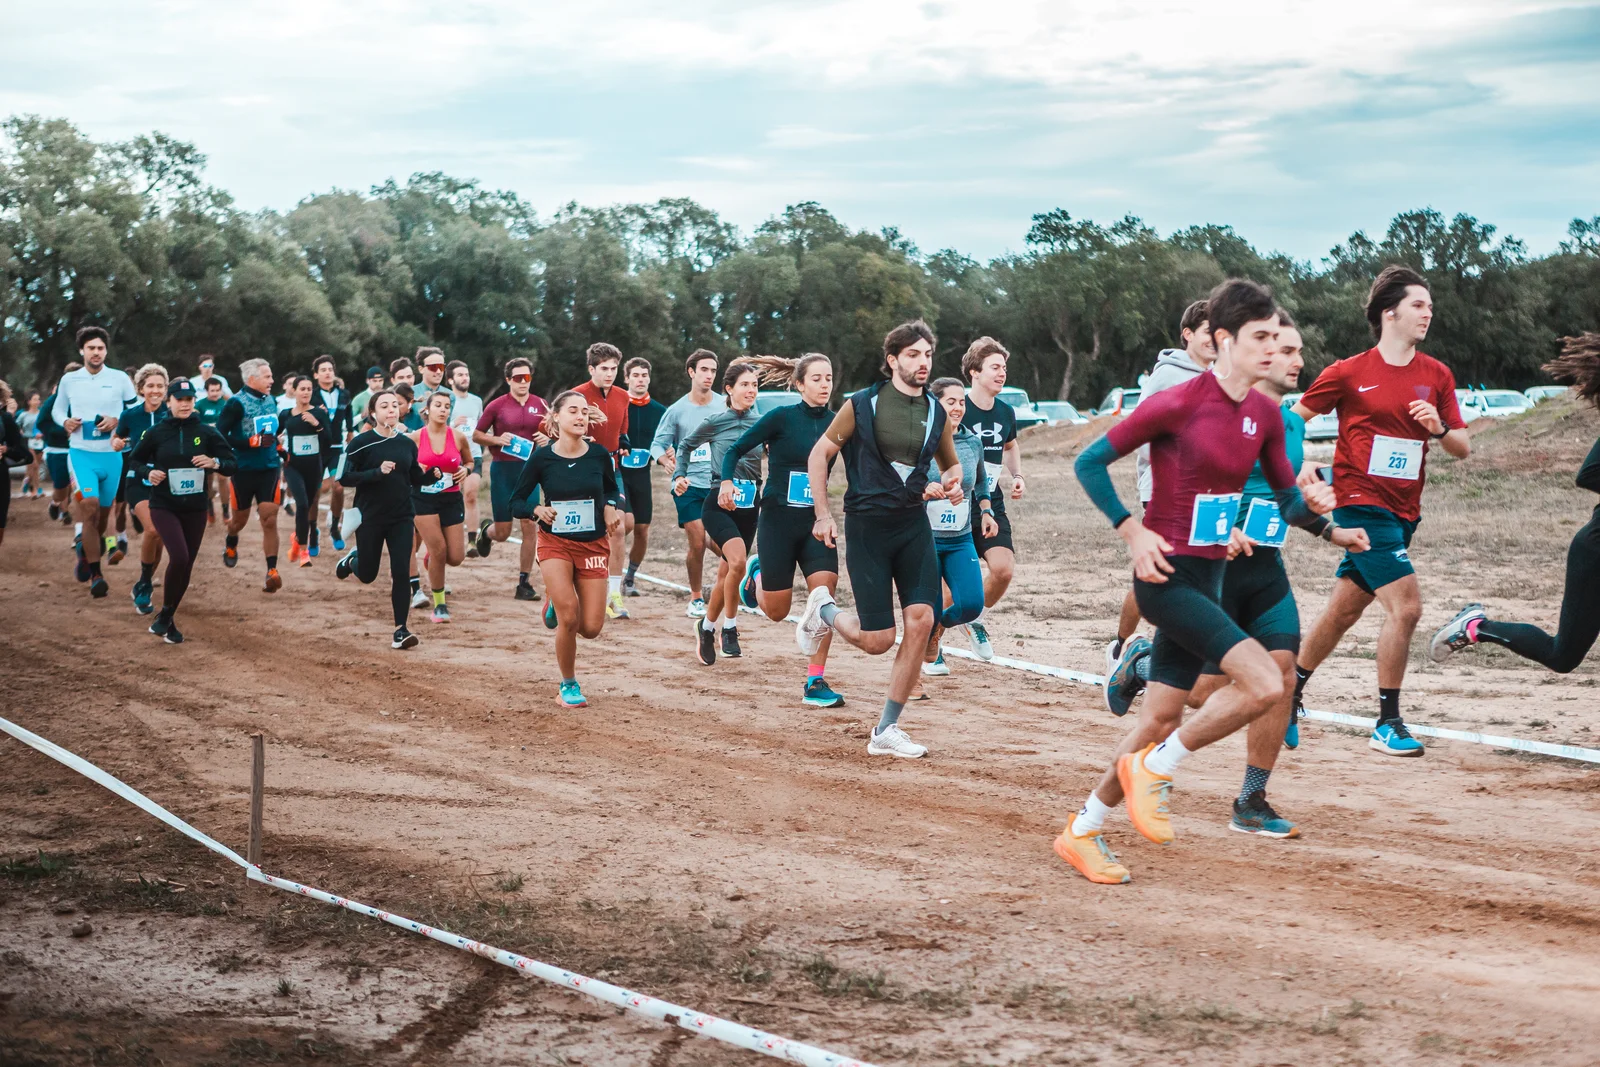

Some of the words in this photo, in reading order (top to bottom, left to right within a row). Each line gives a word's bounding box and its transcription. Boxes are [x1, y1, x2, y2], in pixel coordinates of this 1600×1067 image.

[694, 449, 707, 457] 260
[1388, 456, 1408, 470] 237
[180, 480, 195, 489] 268
[565, 514, 581, 525] 247
[940, 513, 956, 524] 241
[584, 555, 608, 571] NIK
